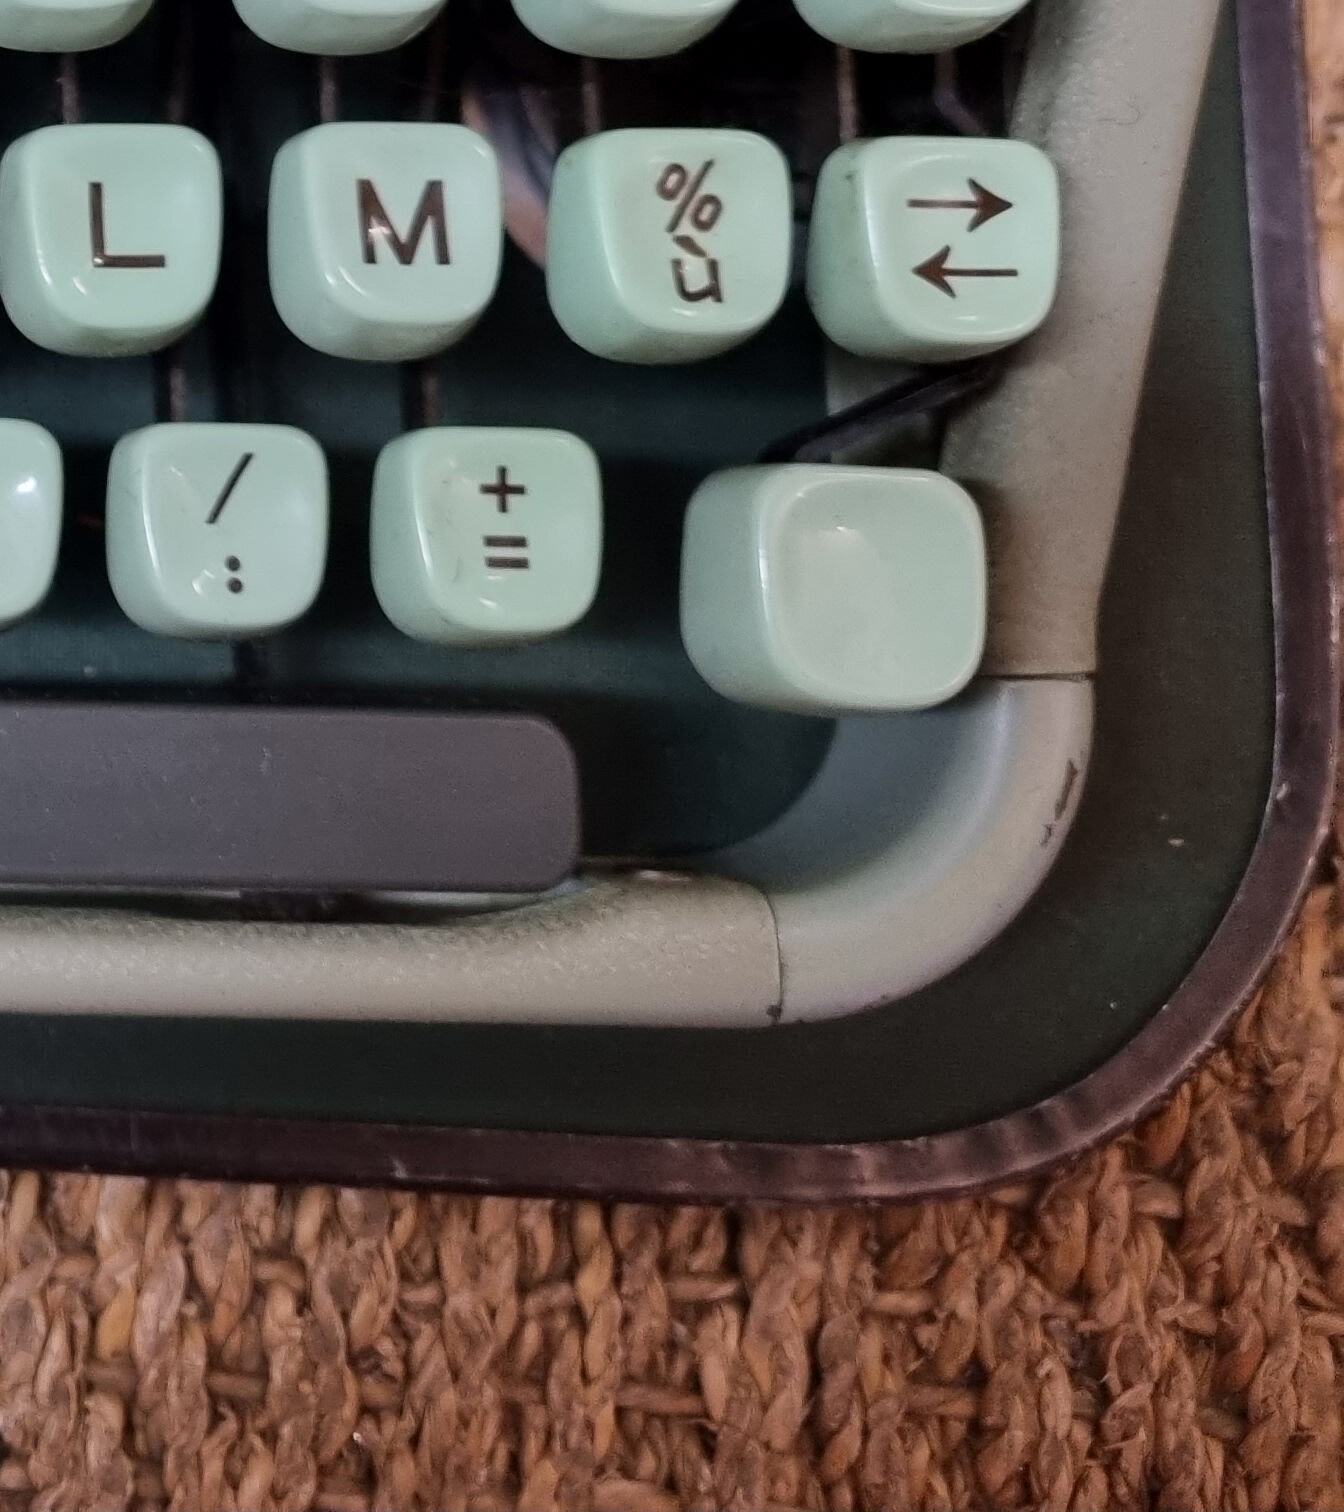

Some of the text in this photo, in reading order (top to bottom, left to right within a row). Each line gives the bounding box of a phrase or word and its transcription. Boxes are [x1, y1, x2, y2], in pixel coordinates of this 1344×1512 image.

[89, 181, 166, 269] L
[357, 179, 450, 266] M
[655, 157, 724, 233] %
[671, 233, 724, 304] ù
[205, 451, 255, 525] /
[480, 465, 526, 514] +
[483, 535, 530, 570] =
